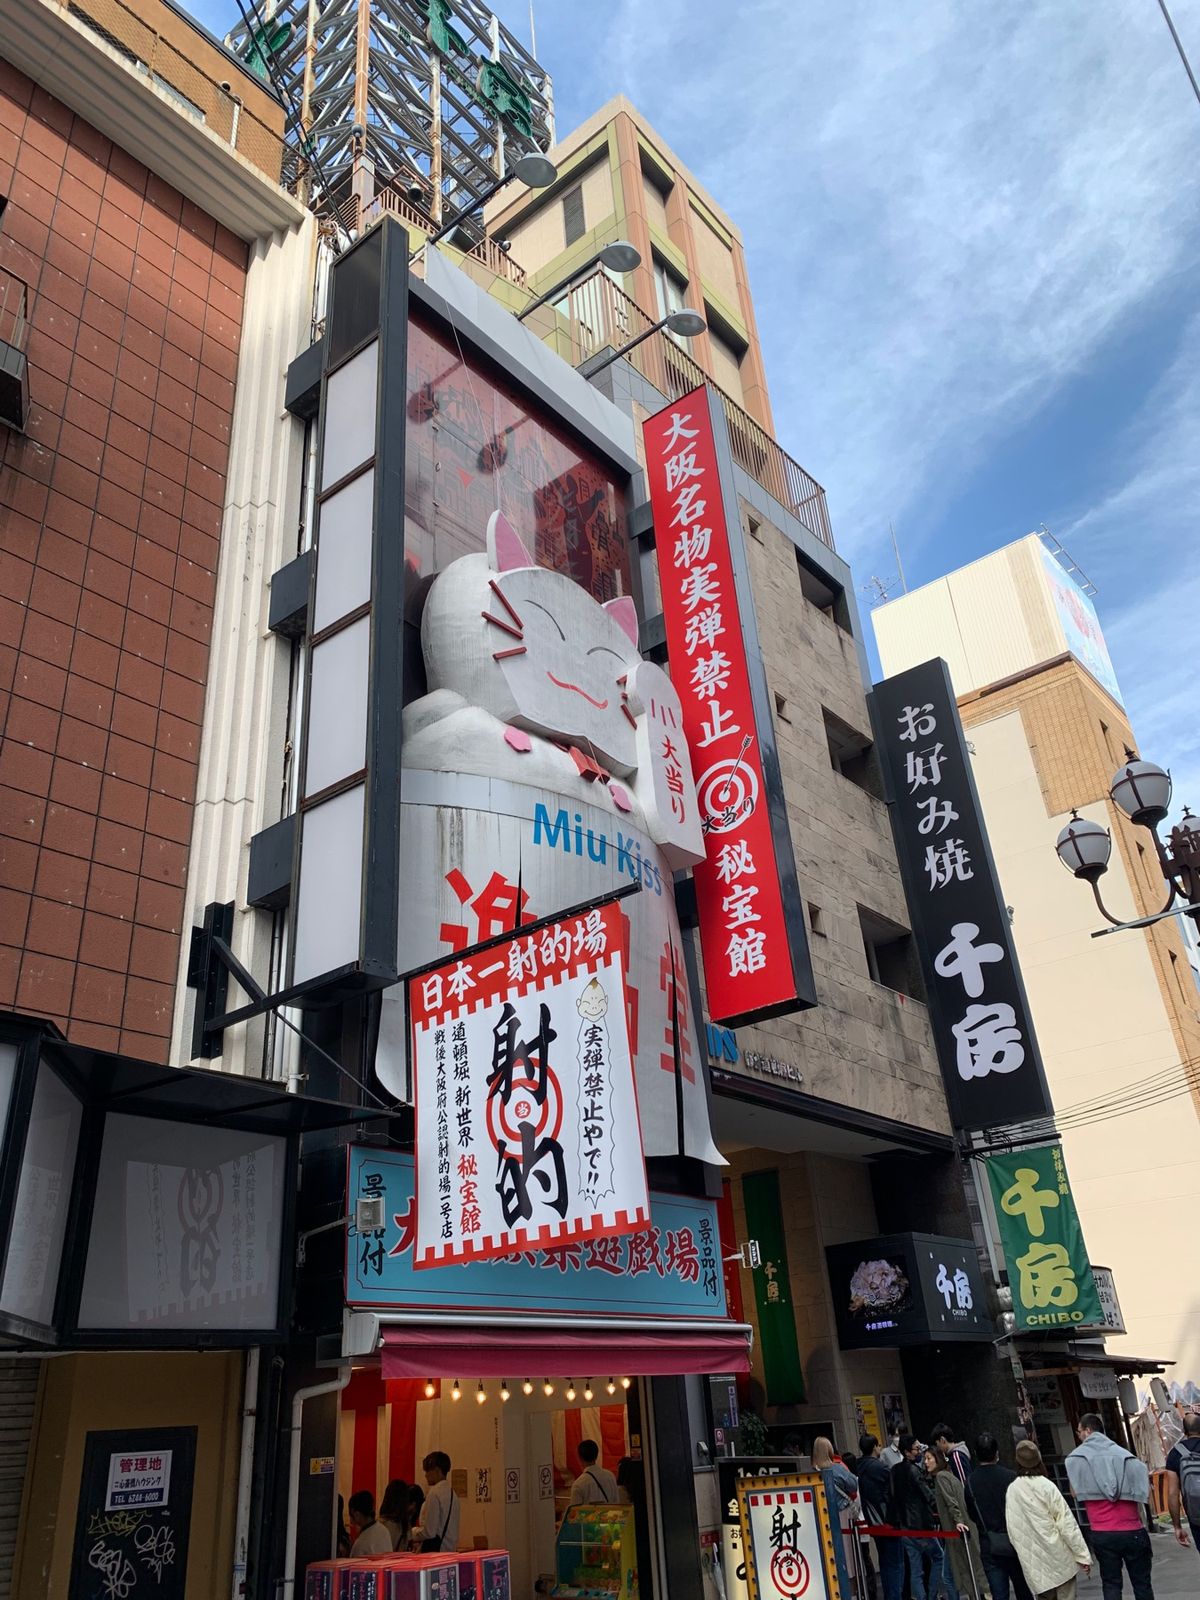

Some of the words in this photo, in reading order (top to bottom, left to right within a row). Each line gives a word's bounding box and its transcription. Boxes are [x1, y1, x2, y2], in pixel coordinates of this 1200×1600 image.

[662, 412, 741, 748] 大阪名物実弾禁止
[661, 734, 685, 824] 大当り
[701, 796, 755, 834] 大当り
[898, 702, 974, 892] お好み焼
[533, 803, 606, 865] Miu
[617, 831, 662, 897] Kiss
[715, 840, 766, 979] 秘宝館
[421, 908, 607, 1012] 日本一射的場
[934, 922, 1026, 1081] 千房
[451, 1021, 471, 1081] 道頓堀
[455, 1084, 474, 1149] 新世界
[485, 1002, 568, 1230] 射的
[457, 1153, 482, 1236] 秘宝館
[698, 1218, 718, 1297] 景品付
[1000, 1168, 1079, 1309] 千房
[936, 1263, 974, 1310] 千房
[1026, 1310, 1084, 1326] CHIBO
[114, 1495, 126, 1504] TEL
[119, 1456, 162, 1473] 管理地
